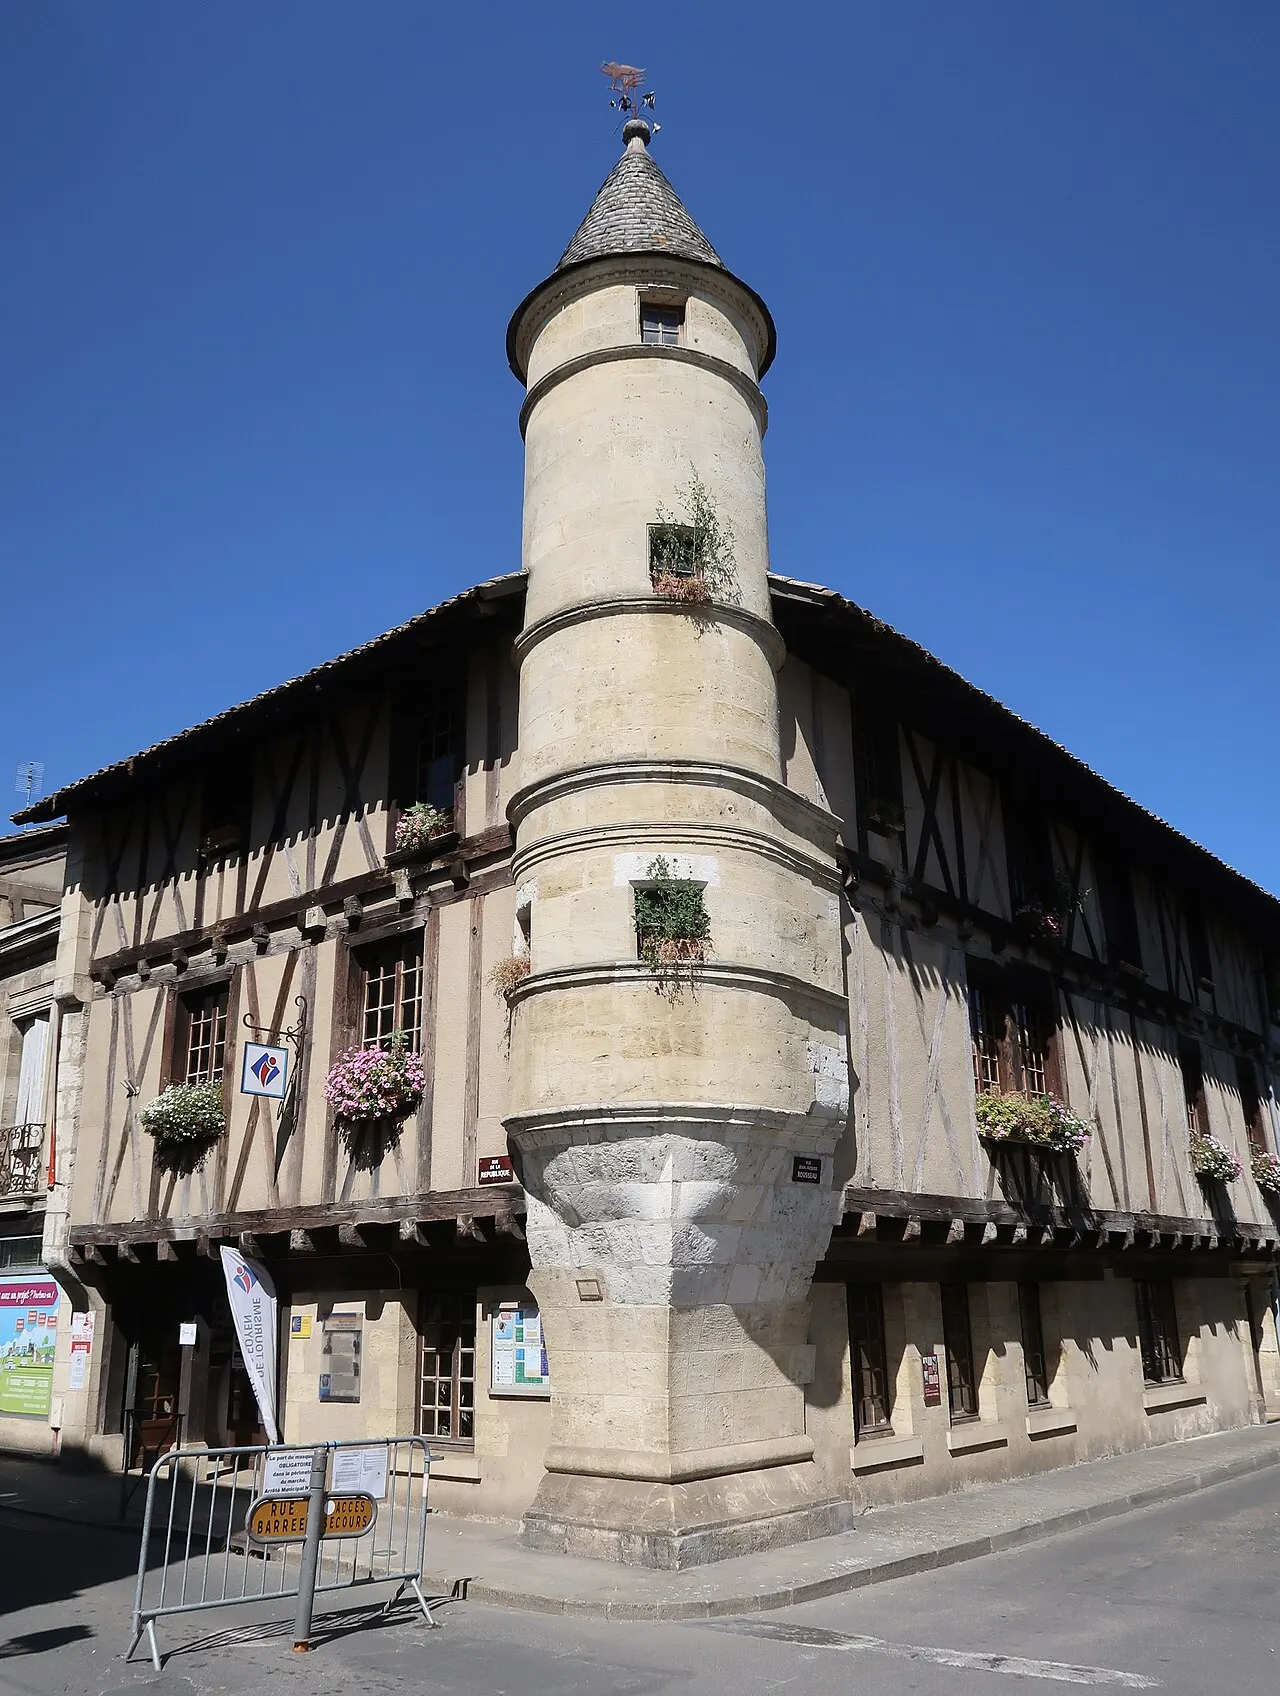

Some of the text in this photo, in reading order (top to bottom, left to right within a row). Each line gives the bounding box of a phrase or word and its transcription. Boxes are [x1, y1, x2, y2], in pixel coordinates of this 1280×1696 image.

[797, 1170, 818, 1180] ROUSSEAU
[276, 1454, 288, 1462] port
[279, 1461, 312, 1469] OBLIGATOIRE
[270, 1502, 295, 1517] RUE
[336, 1501, 366, 1513] ACCES
[257, 1518, 305, 1534] BARREE
